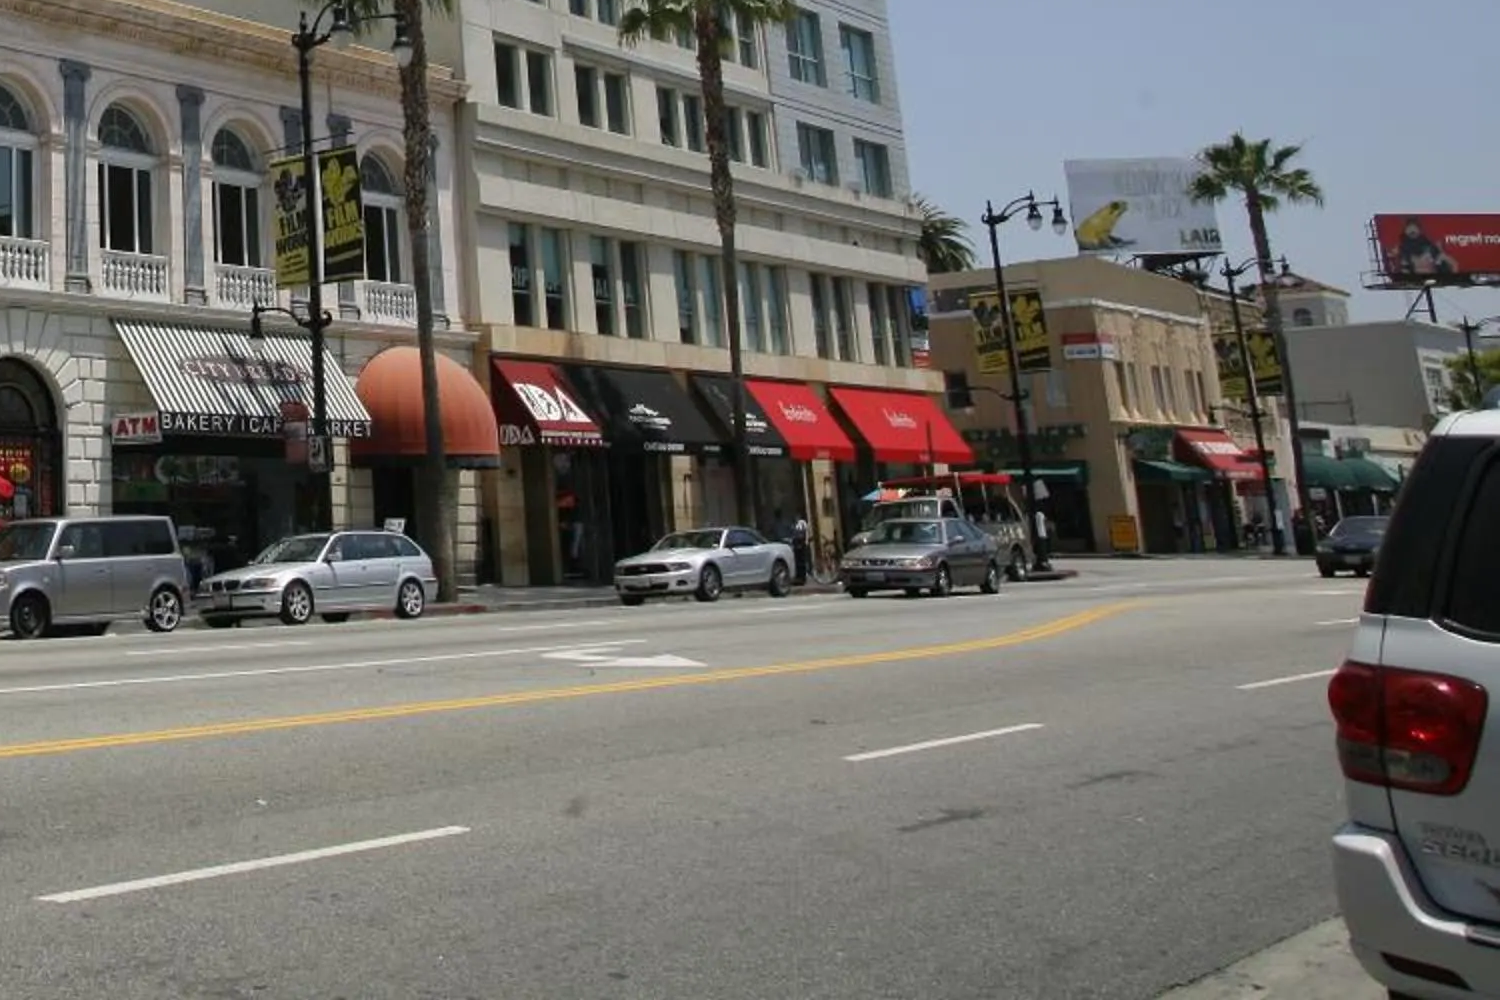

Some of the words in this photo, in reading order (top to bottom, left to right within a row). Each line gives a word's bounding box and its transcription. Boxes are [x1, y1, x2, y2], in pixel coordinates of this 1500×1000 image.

[183, 358, 230, 379] CITY
[115, 417, 158, 437] ATM
[161, 412, 234, 432] BAKERY
[249, 416, 283, 434] CAF
